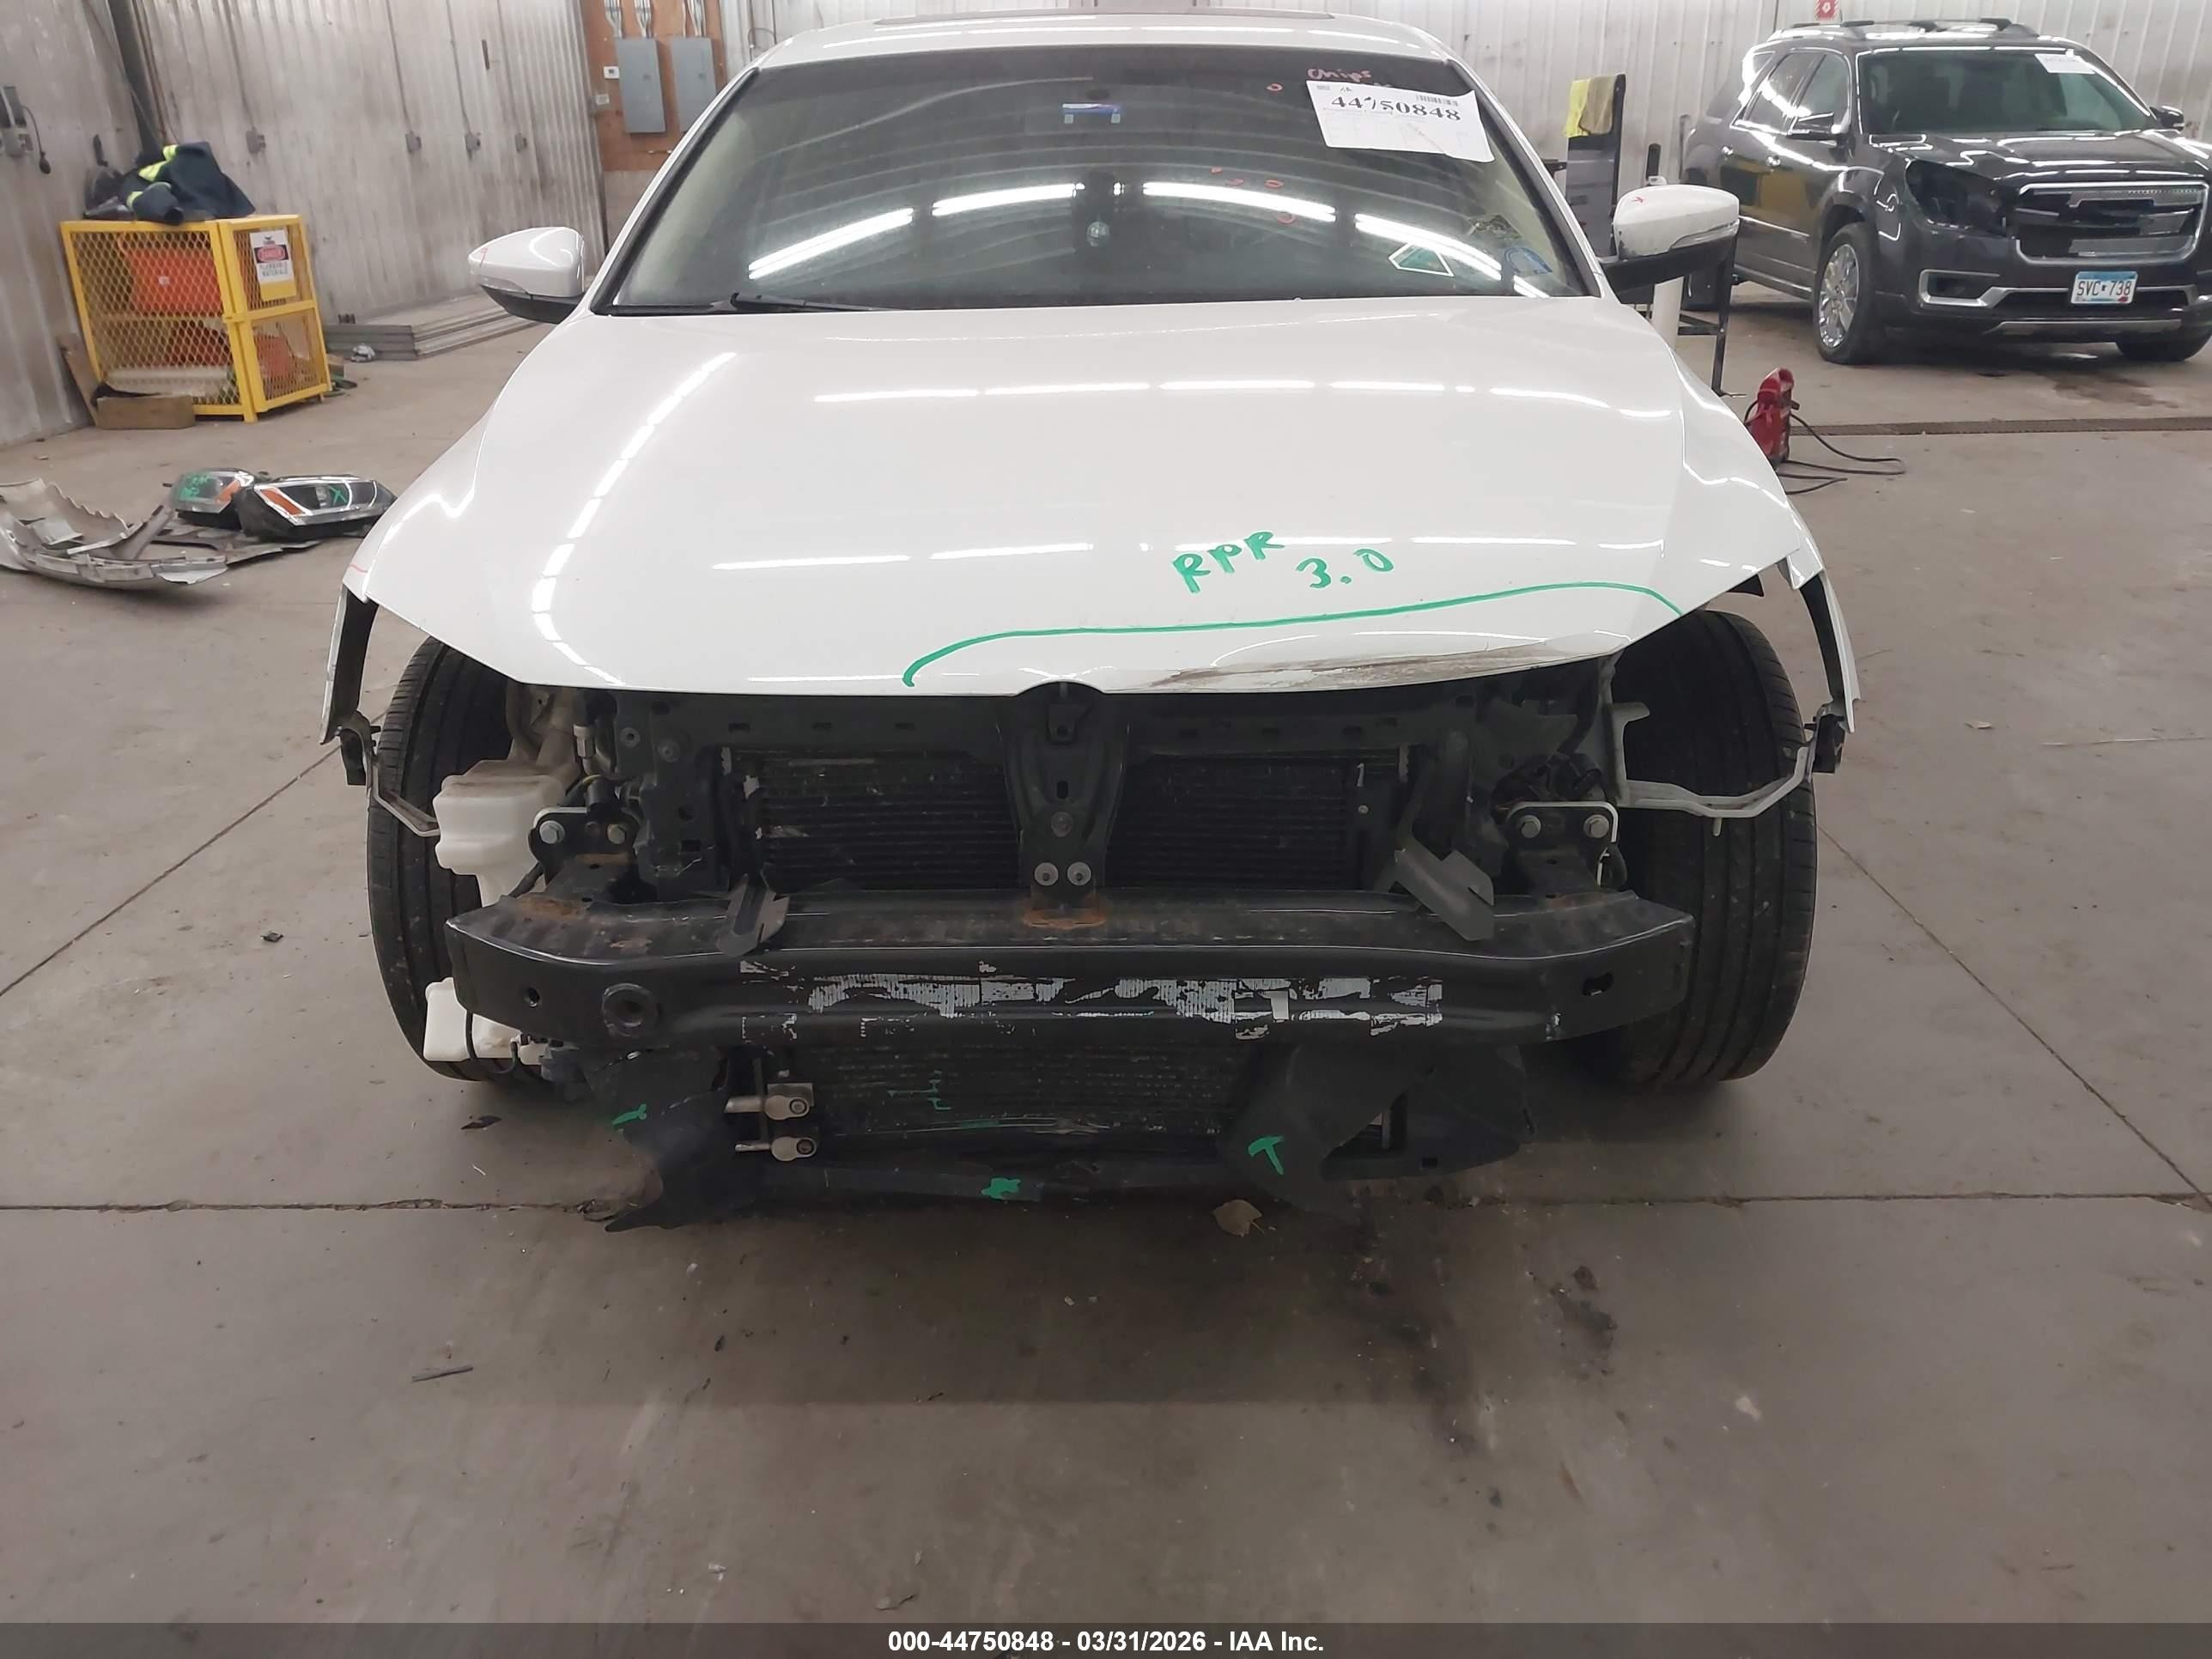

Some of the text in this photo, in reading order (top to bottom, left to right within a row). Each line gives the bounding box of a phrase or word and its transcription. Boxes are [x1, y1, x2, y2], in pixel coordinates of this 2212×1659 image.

[1331, 96, 1461, 121] 44750848
[2077, 280, 2132, 296] SVC 738
[1172, 531, 1285, 594] RPR
[1296, 548, 1395, 589] 3.0
